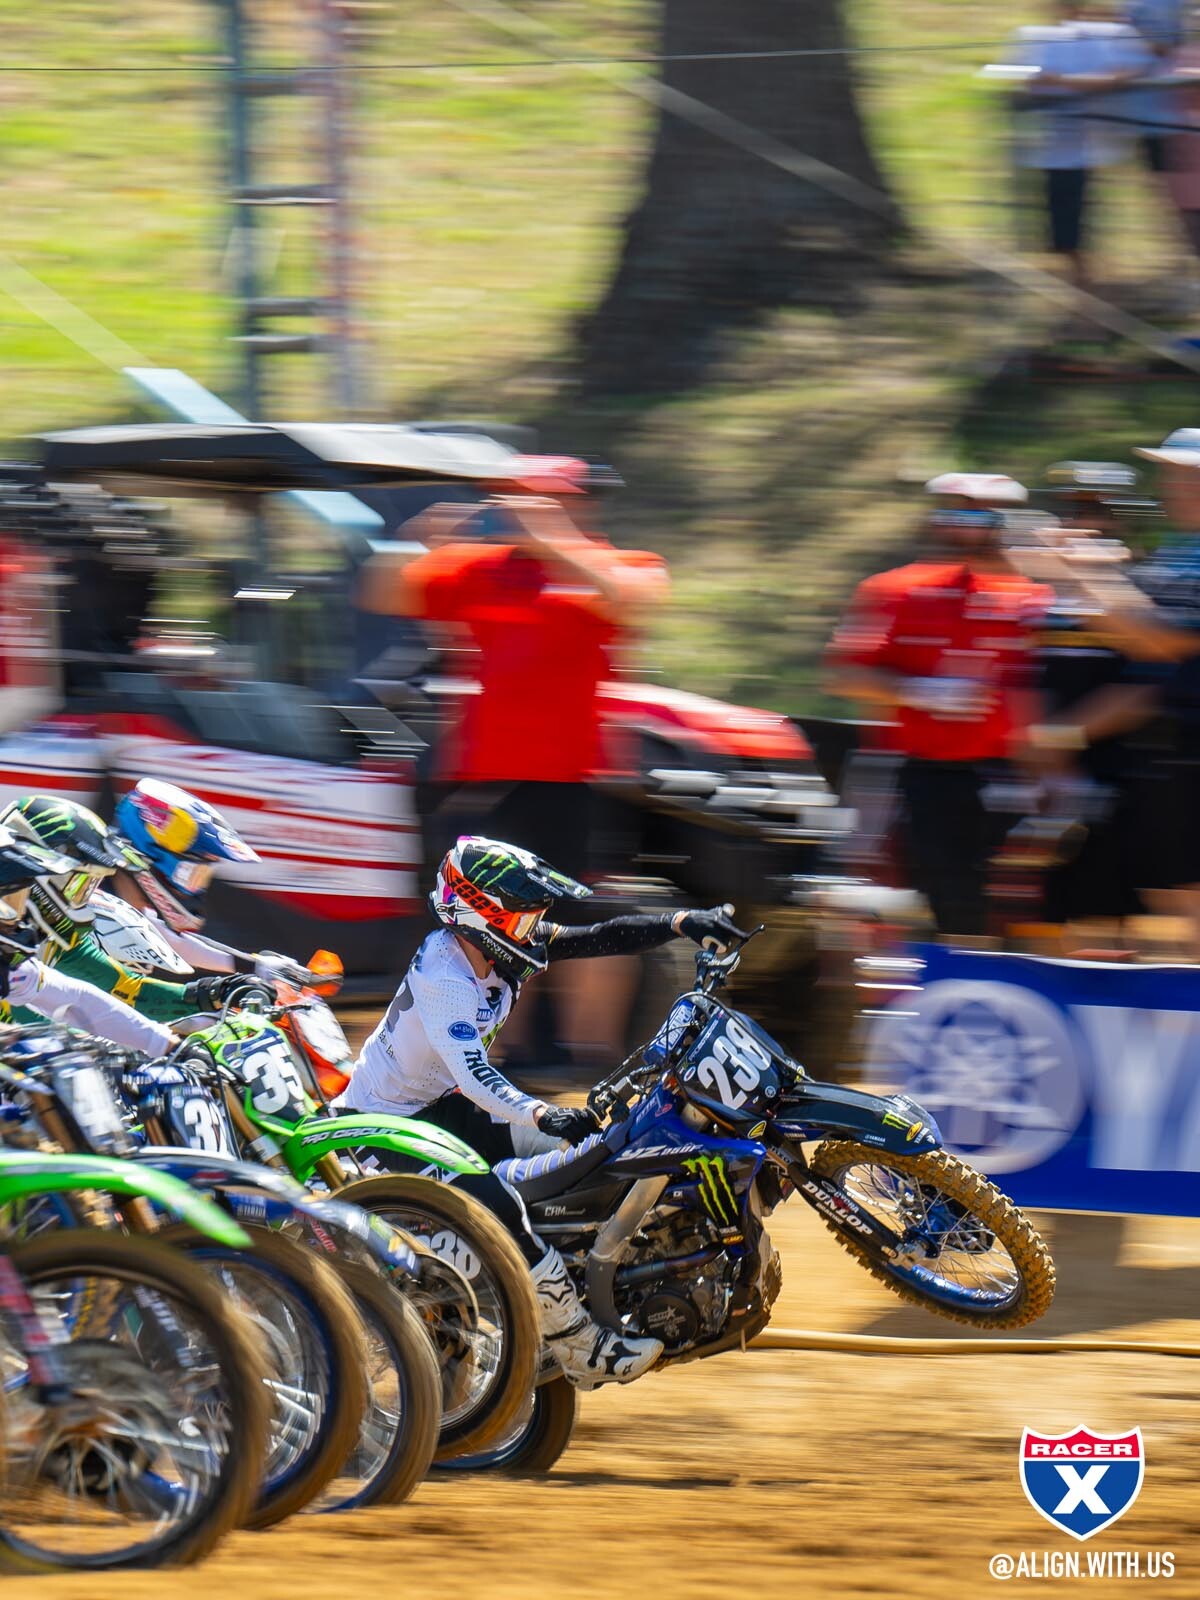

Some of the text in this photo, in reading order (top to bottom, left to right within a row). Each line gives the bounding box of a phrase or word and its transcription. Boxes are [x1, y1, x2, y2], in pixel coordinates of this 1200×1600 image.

[450, 876, 504, 925] 100%
[697, 1017, 772, 1111] 238
[331, 1127, 402, 1141] CIRCUIT
[801, 1180, 873, 1236] DUNLOP
